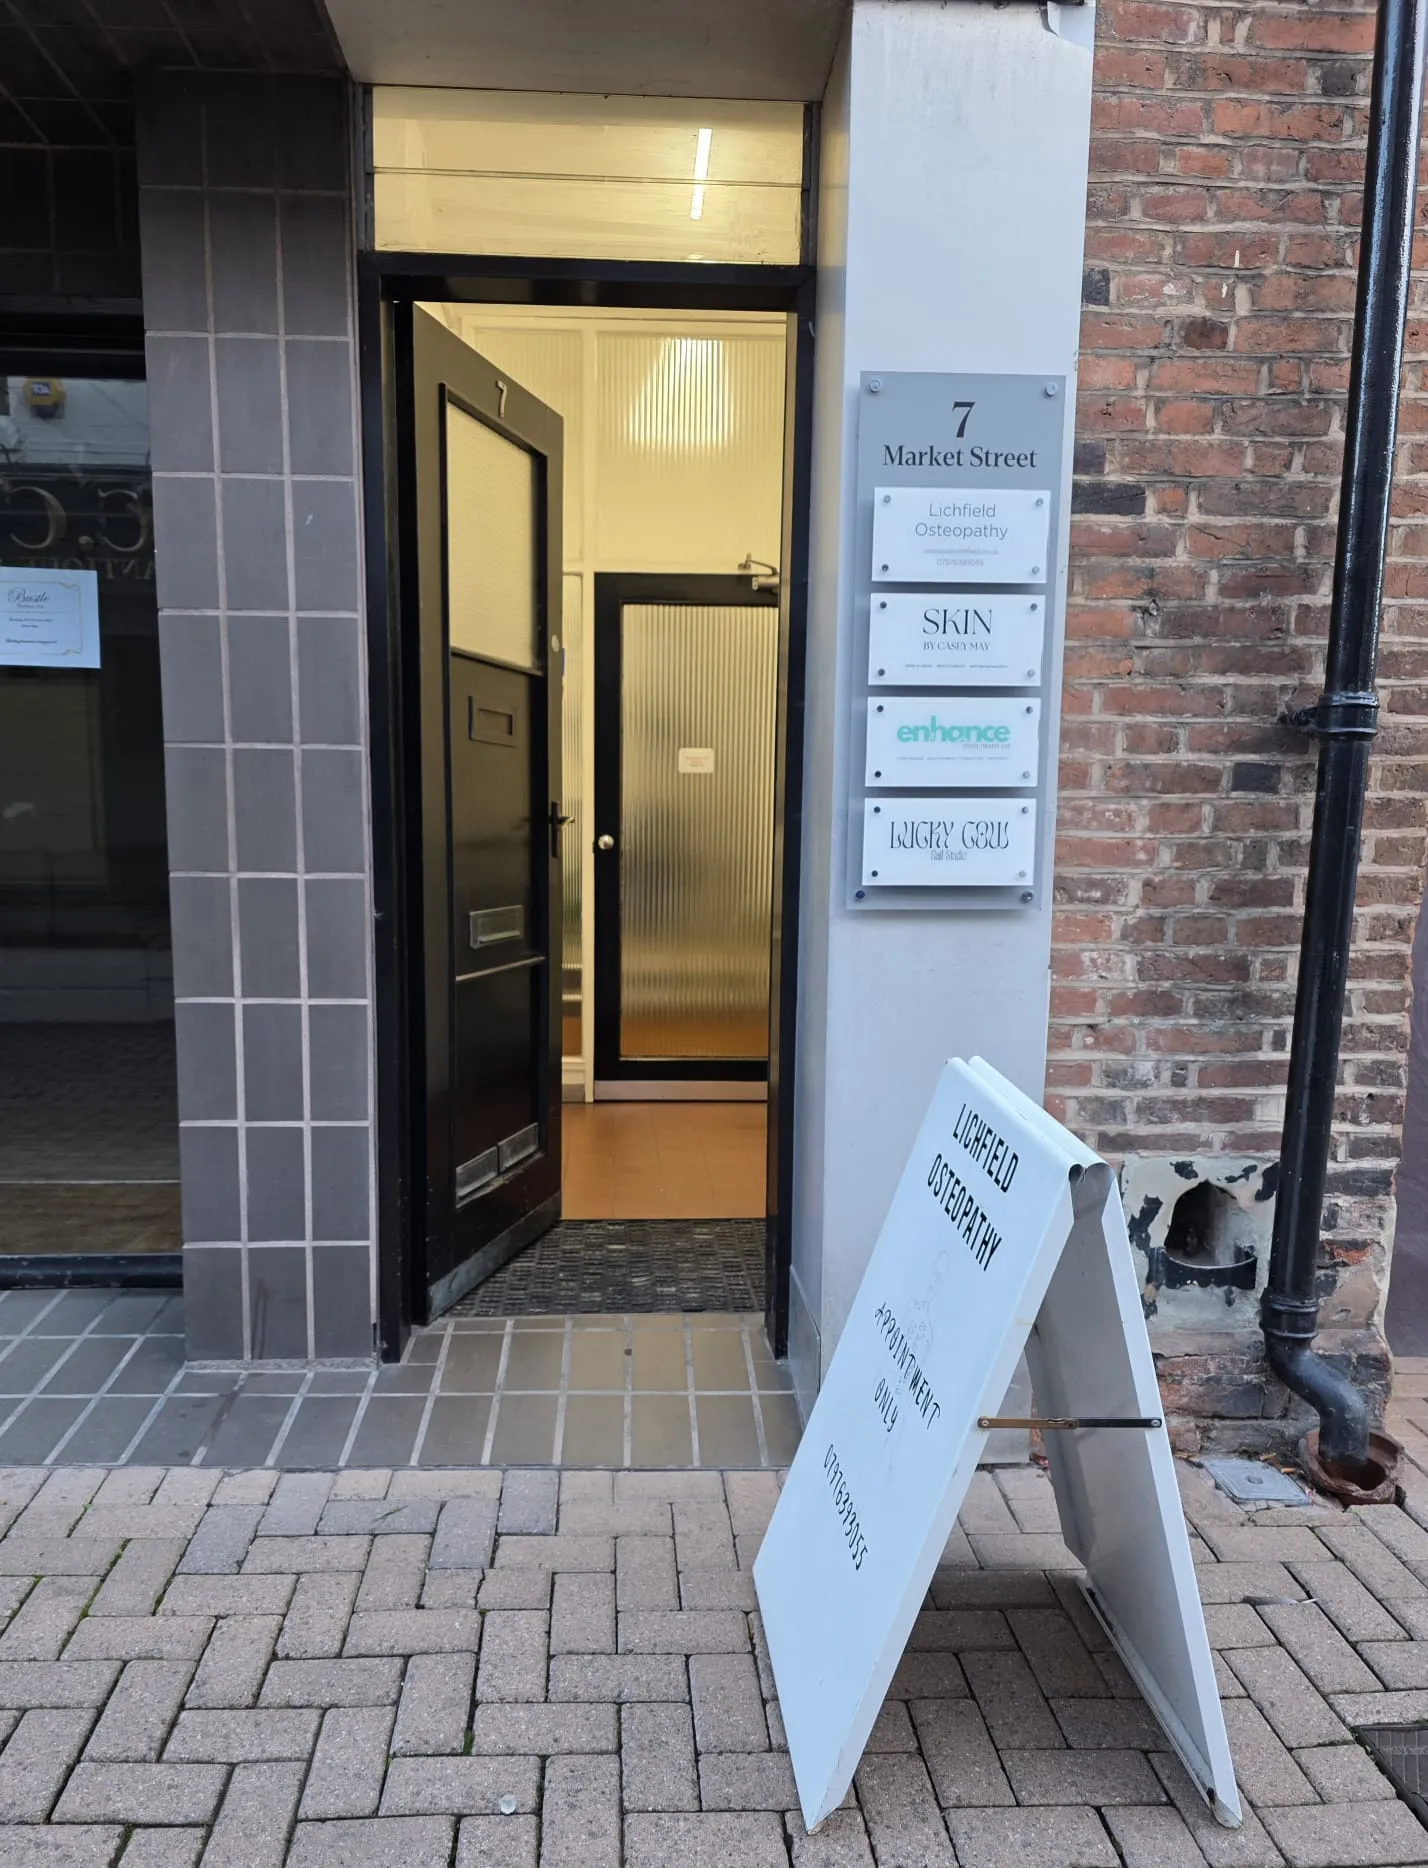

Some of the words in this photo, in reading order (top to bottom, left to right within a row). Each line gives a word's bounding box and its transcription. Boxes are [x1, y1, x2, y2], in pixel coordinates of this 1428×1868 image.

[496, 380, 508, 418] 7
[952, 401, 976, 438] 7
[883, 444, 964, 467] Market
[969, 446, 1038, 468] Street
[929, 503, 997, 518] Lichfield
[915, 522, 1009, 541] Osteopathy
[922, 608, 993, 636] SKIN
[923, 641, 936, 651] BY
[937, 641, 968, 651] CASEY
[968, 641, 991, 651] MAY
[896, 714, 1011, 743] enhance
[890, 820, 955, 849] LUCKY
[961, 820, 1010, 849] COW
[952, 1103, 1019, 1193] LICHFIELD
[927, 1153, 1002, 1271] OSTEOPATHY
[874, 1302, 941, 1430] APPOINTMENT
[874, 1378, 899, 1432] ONLY
[824, 1444, 868, 1571] 07976393055
